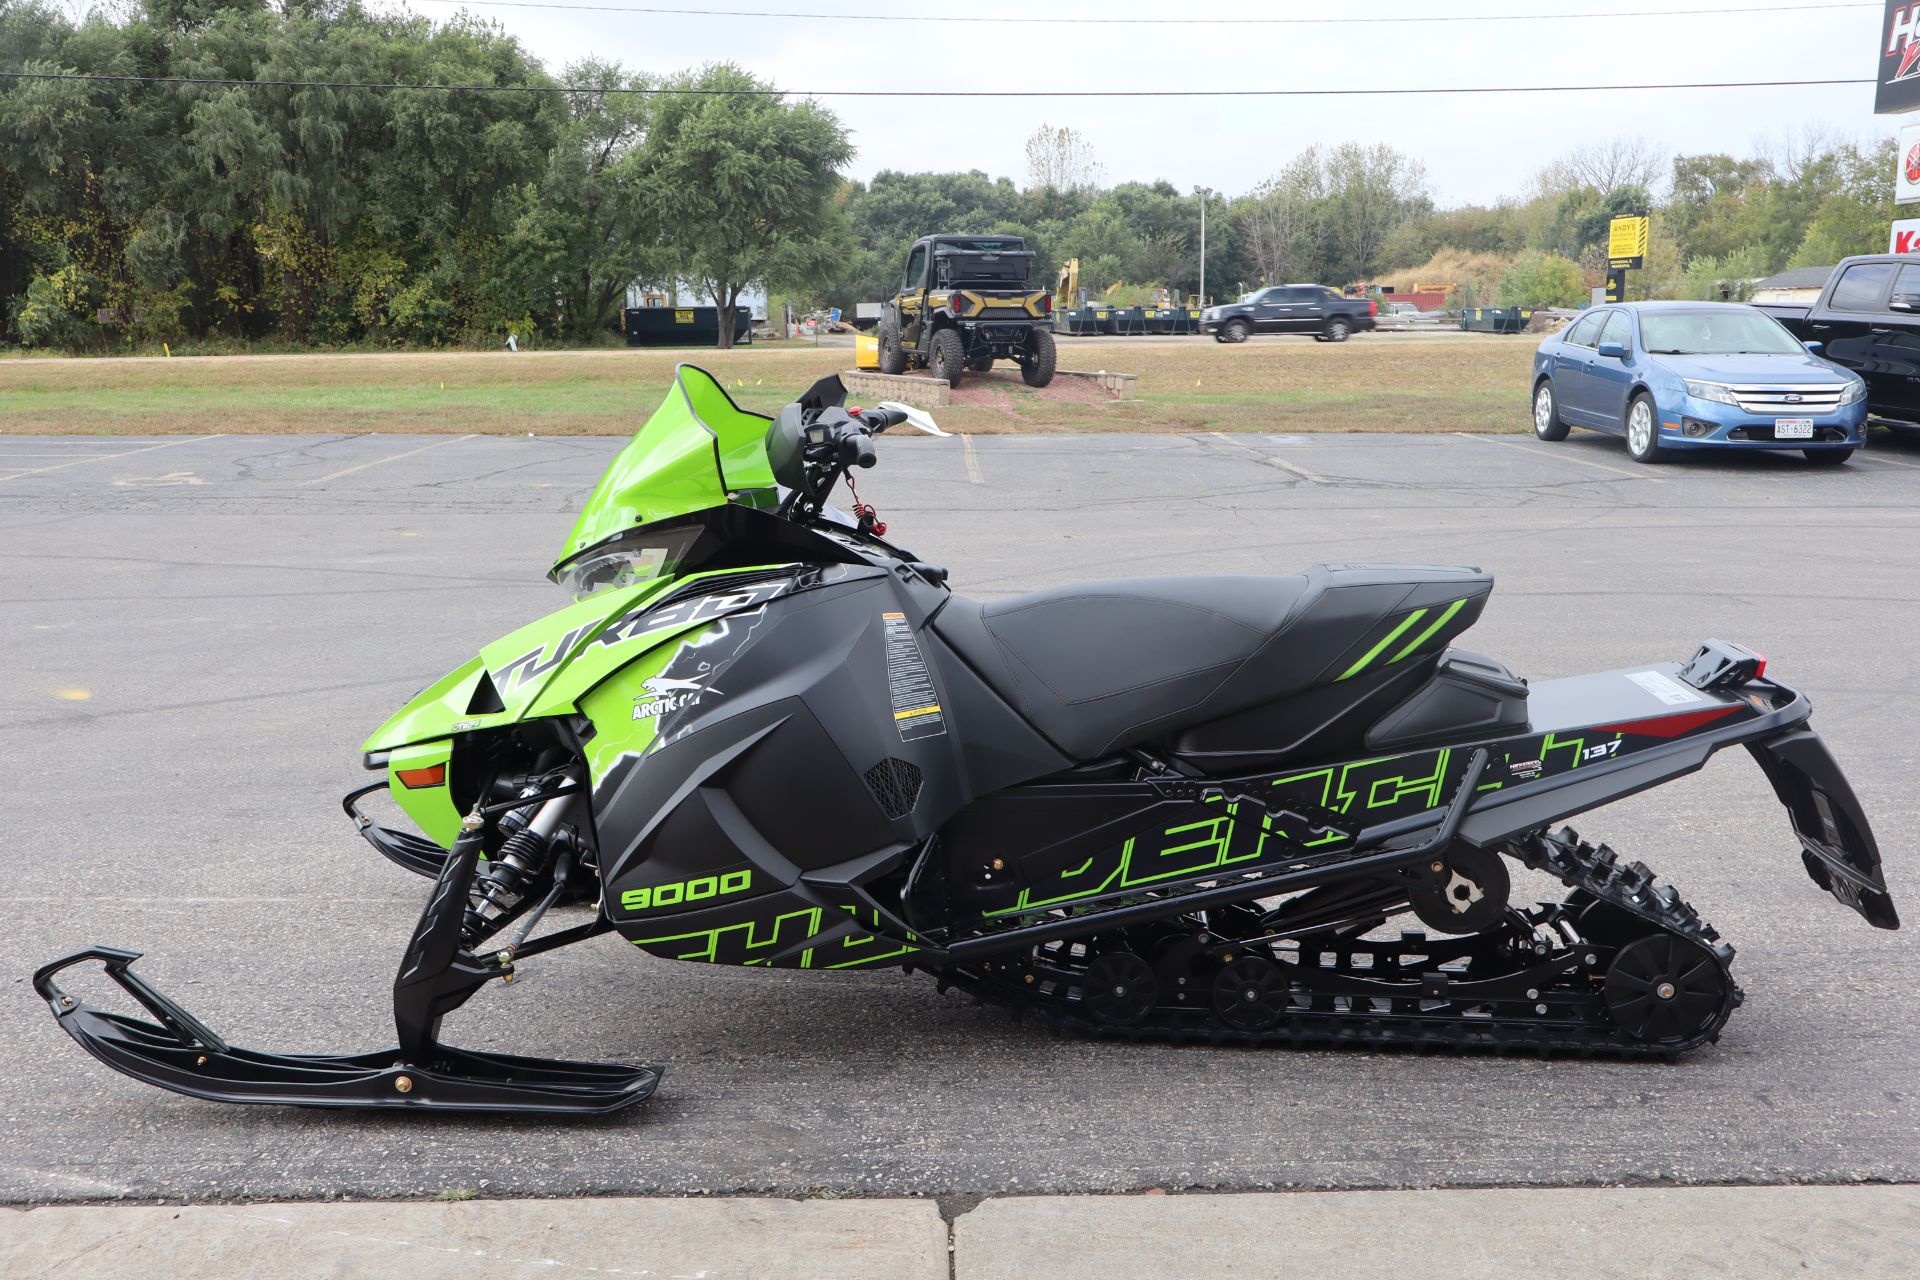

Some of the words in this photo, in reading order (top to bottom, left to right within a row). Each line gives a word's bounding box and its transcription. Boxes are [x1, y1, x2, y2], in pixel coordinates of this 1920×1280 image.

[1613, 224, 1636, 232] ANDY'S
[491, 581, 789, 698] TURBO
[632, 696, 678, 721] ARCTIC
[1583, 739, 1622, 761] 137
[621, 869, 752, 911] 9000
